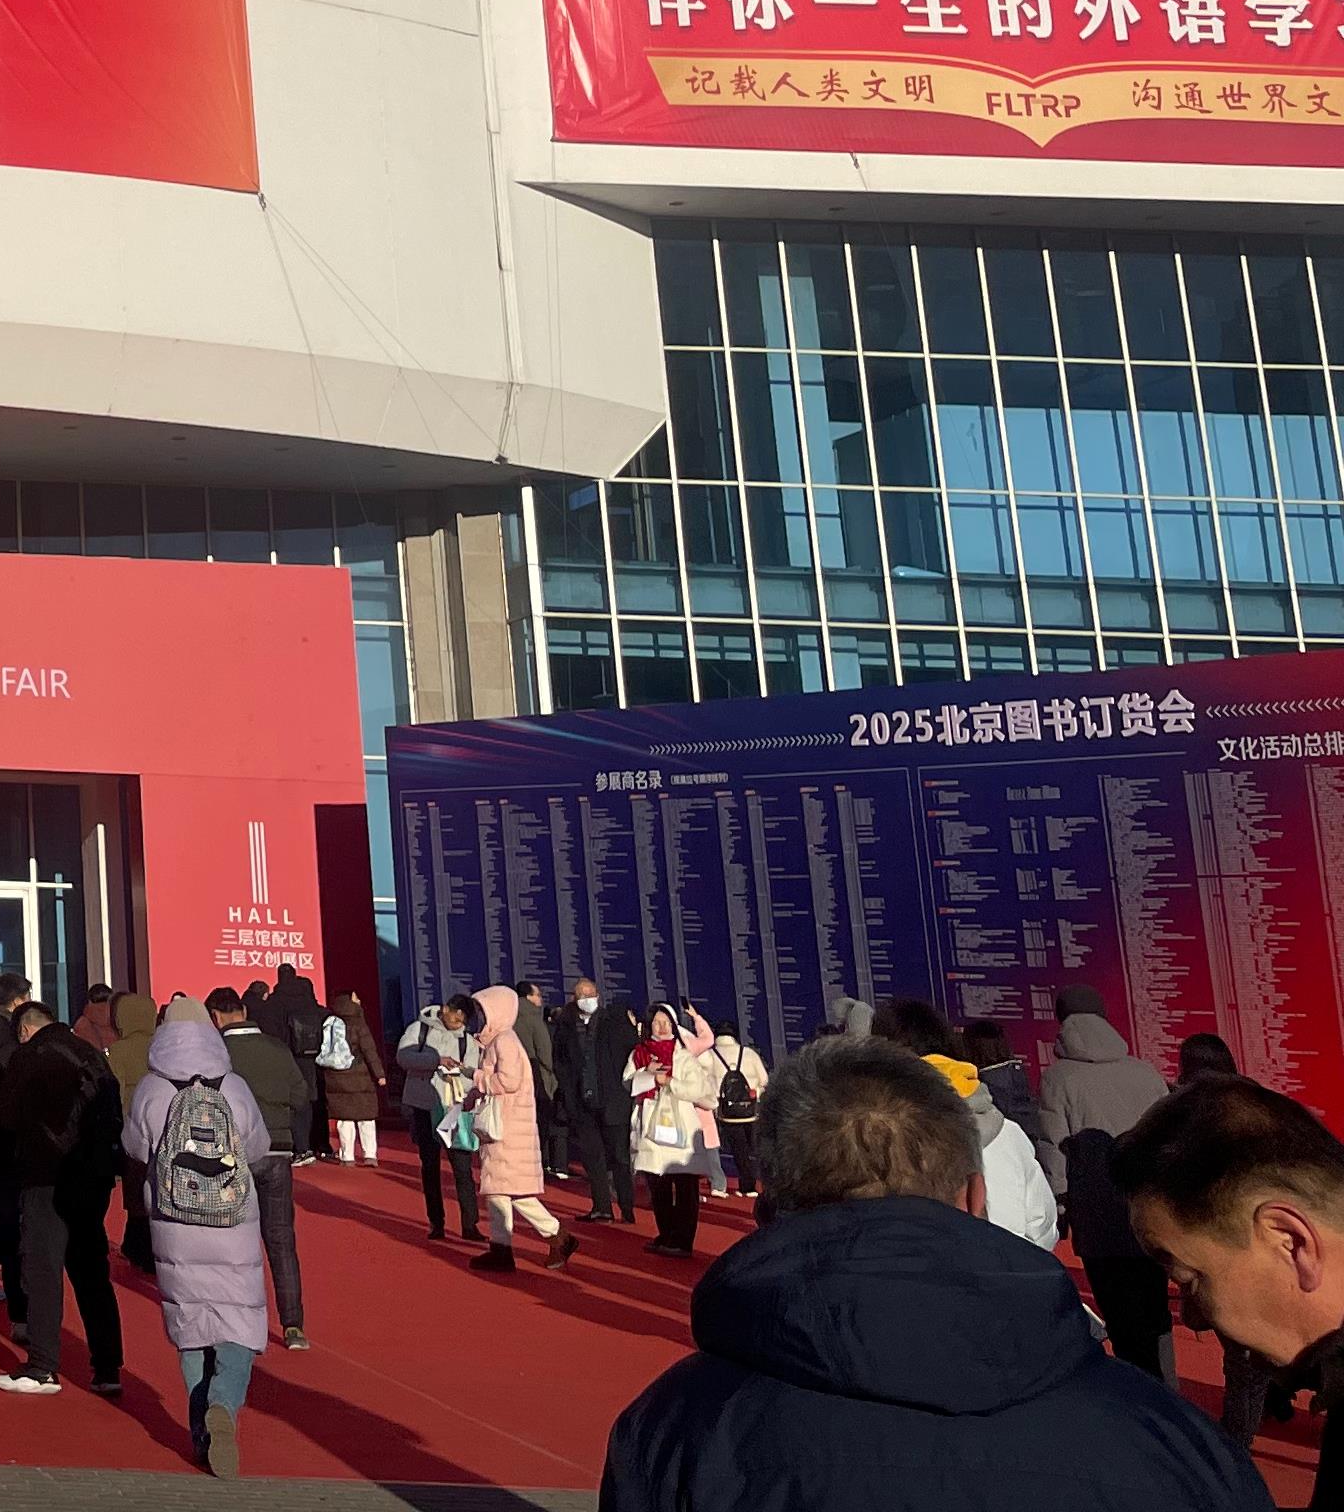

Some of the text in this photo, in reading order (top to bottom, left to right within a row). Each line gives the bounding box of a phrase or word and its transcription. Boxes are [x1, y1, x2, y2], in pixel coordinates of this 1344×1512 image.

[685, 65, 936, 105] 记载人类文明
[1131, 78, 1343, 118] 沟通世界文
[986, 92, 1081, 118] FLTRP
[2, 667, 71, 699] FAIR
[849, 689, 1195, 747] 2025北京图书订货会
[1217, 731, 1344, 761] 文化活动总排
[595, 770, 663, 792] 参展商名录
[228, 906, 295, 925] HALL
[221, 928, 305, 948] 三层馆配区
[214, 949, 315, 969] 三层文创展区
